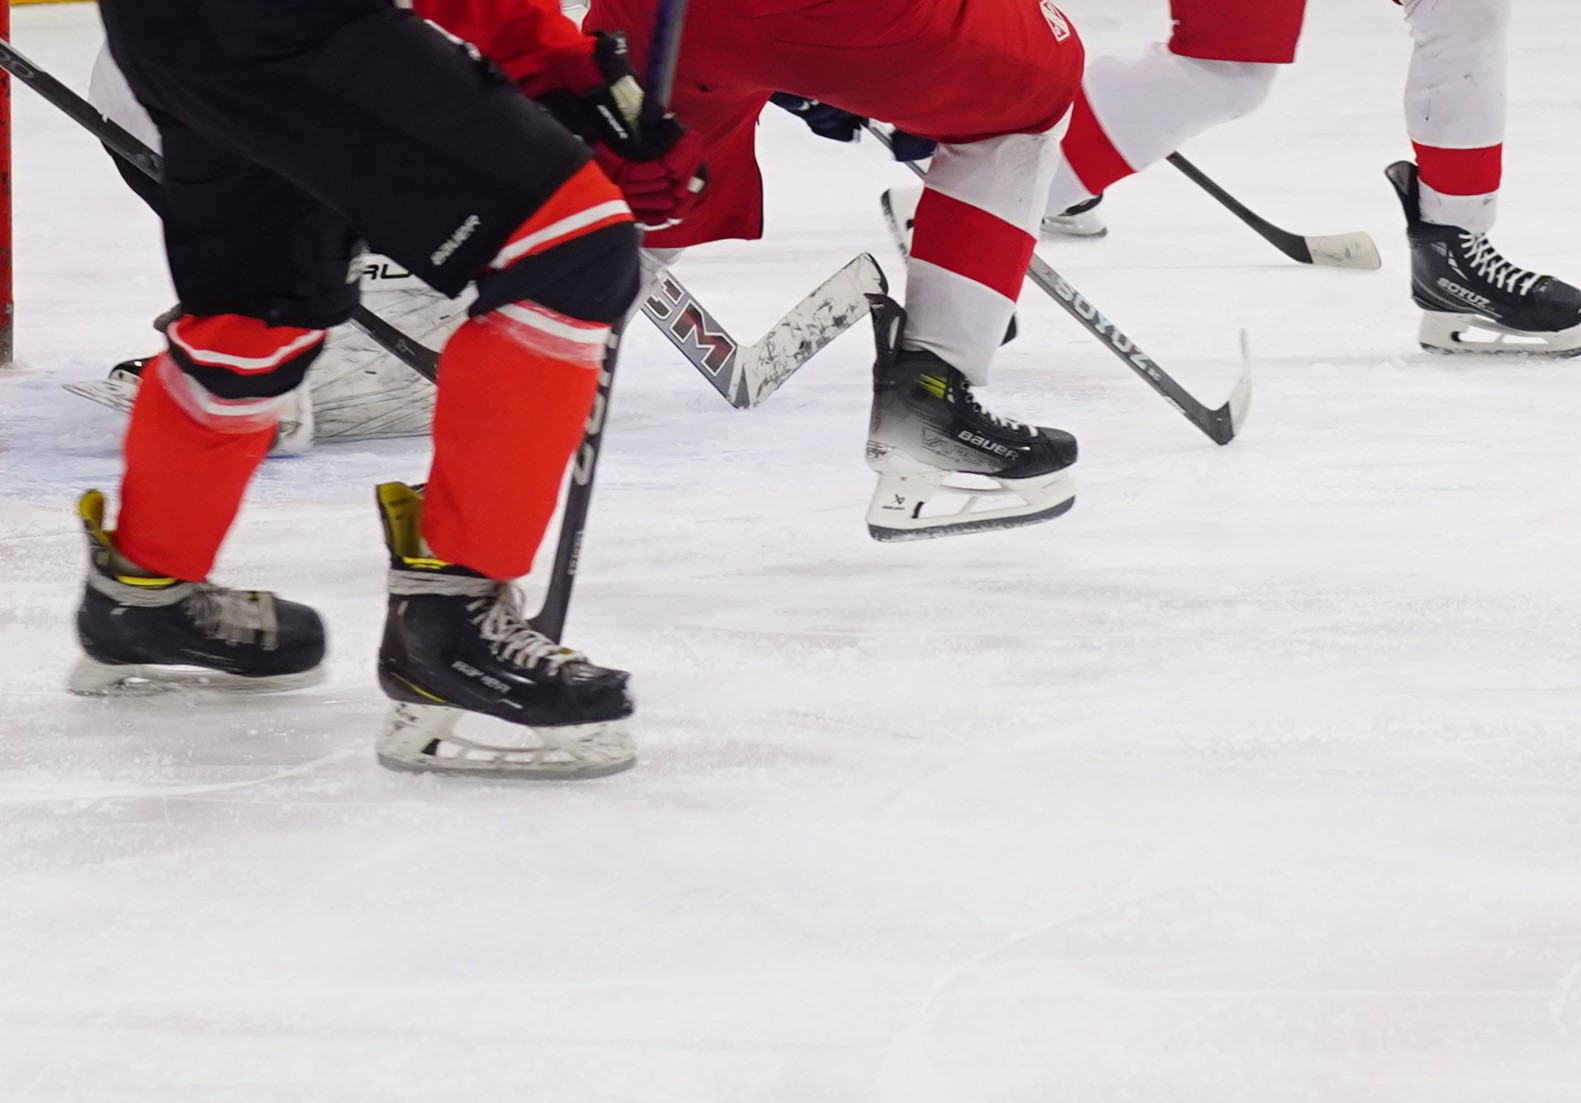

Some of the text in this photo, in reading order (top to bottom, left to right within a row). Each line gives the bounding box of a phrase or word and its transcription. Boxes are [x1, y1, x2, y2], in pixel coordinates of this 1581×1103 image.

[1436, 277, 1491, 309] SOYUZ
[1053, 276, 1151, 372] SOYUZ
[957, 429, 1021, 461] BAUER
